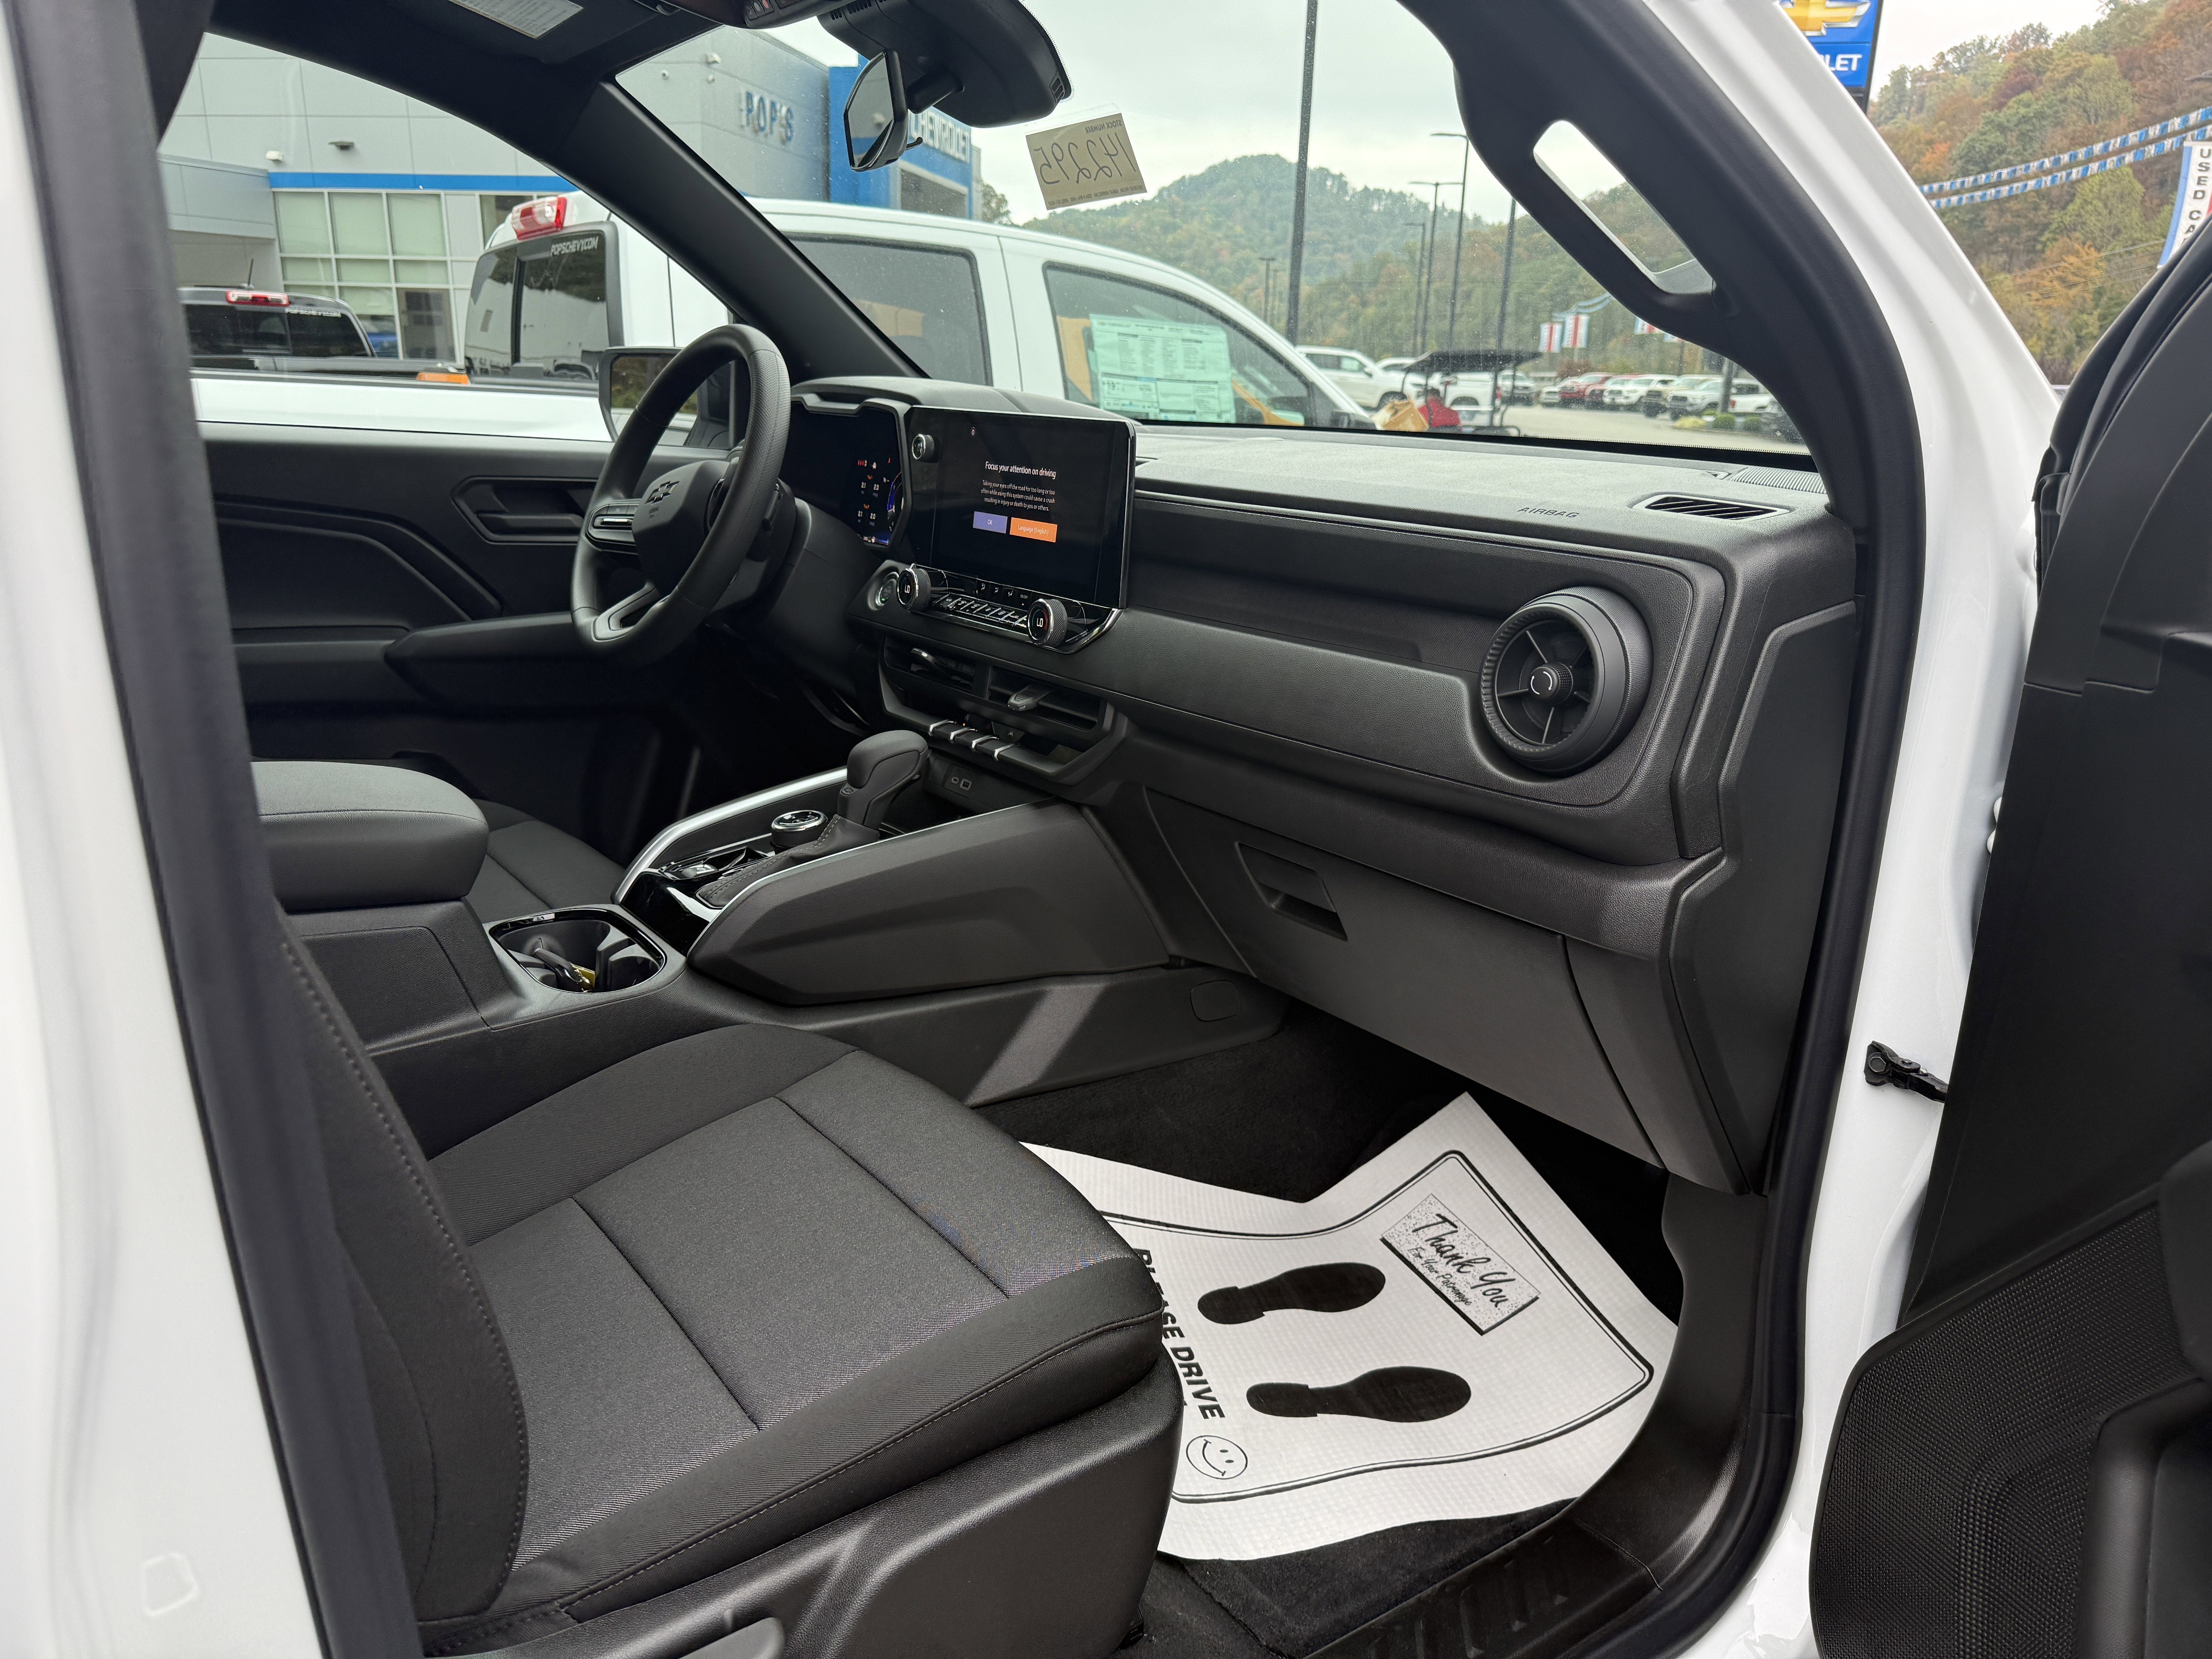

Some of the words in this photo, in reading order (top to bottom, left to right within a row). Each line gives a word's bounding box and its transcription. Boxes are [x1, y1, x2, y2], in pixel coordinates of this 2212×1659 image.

[2193, 148, 2212, 199] USED
[985, 461, 998, 471] Focus
[1010, 465, 1031, 474] attention
[1039, 467, 1056, 480] driving
[1517, 507, 1580, 517] AIRBAG
[1018, 525, 1034, 533] Language
[1034, 527, 1049, 536] (English)
[1412, 1213, 1491, 1273] Thank
[1471, 1272, 1516, 1307] You
[1133, 1248, 1185, 1339] PSE
[1170, 1346, 1226, 1420] DRIVE
